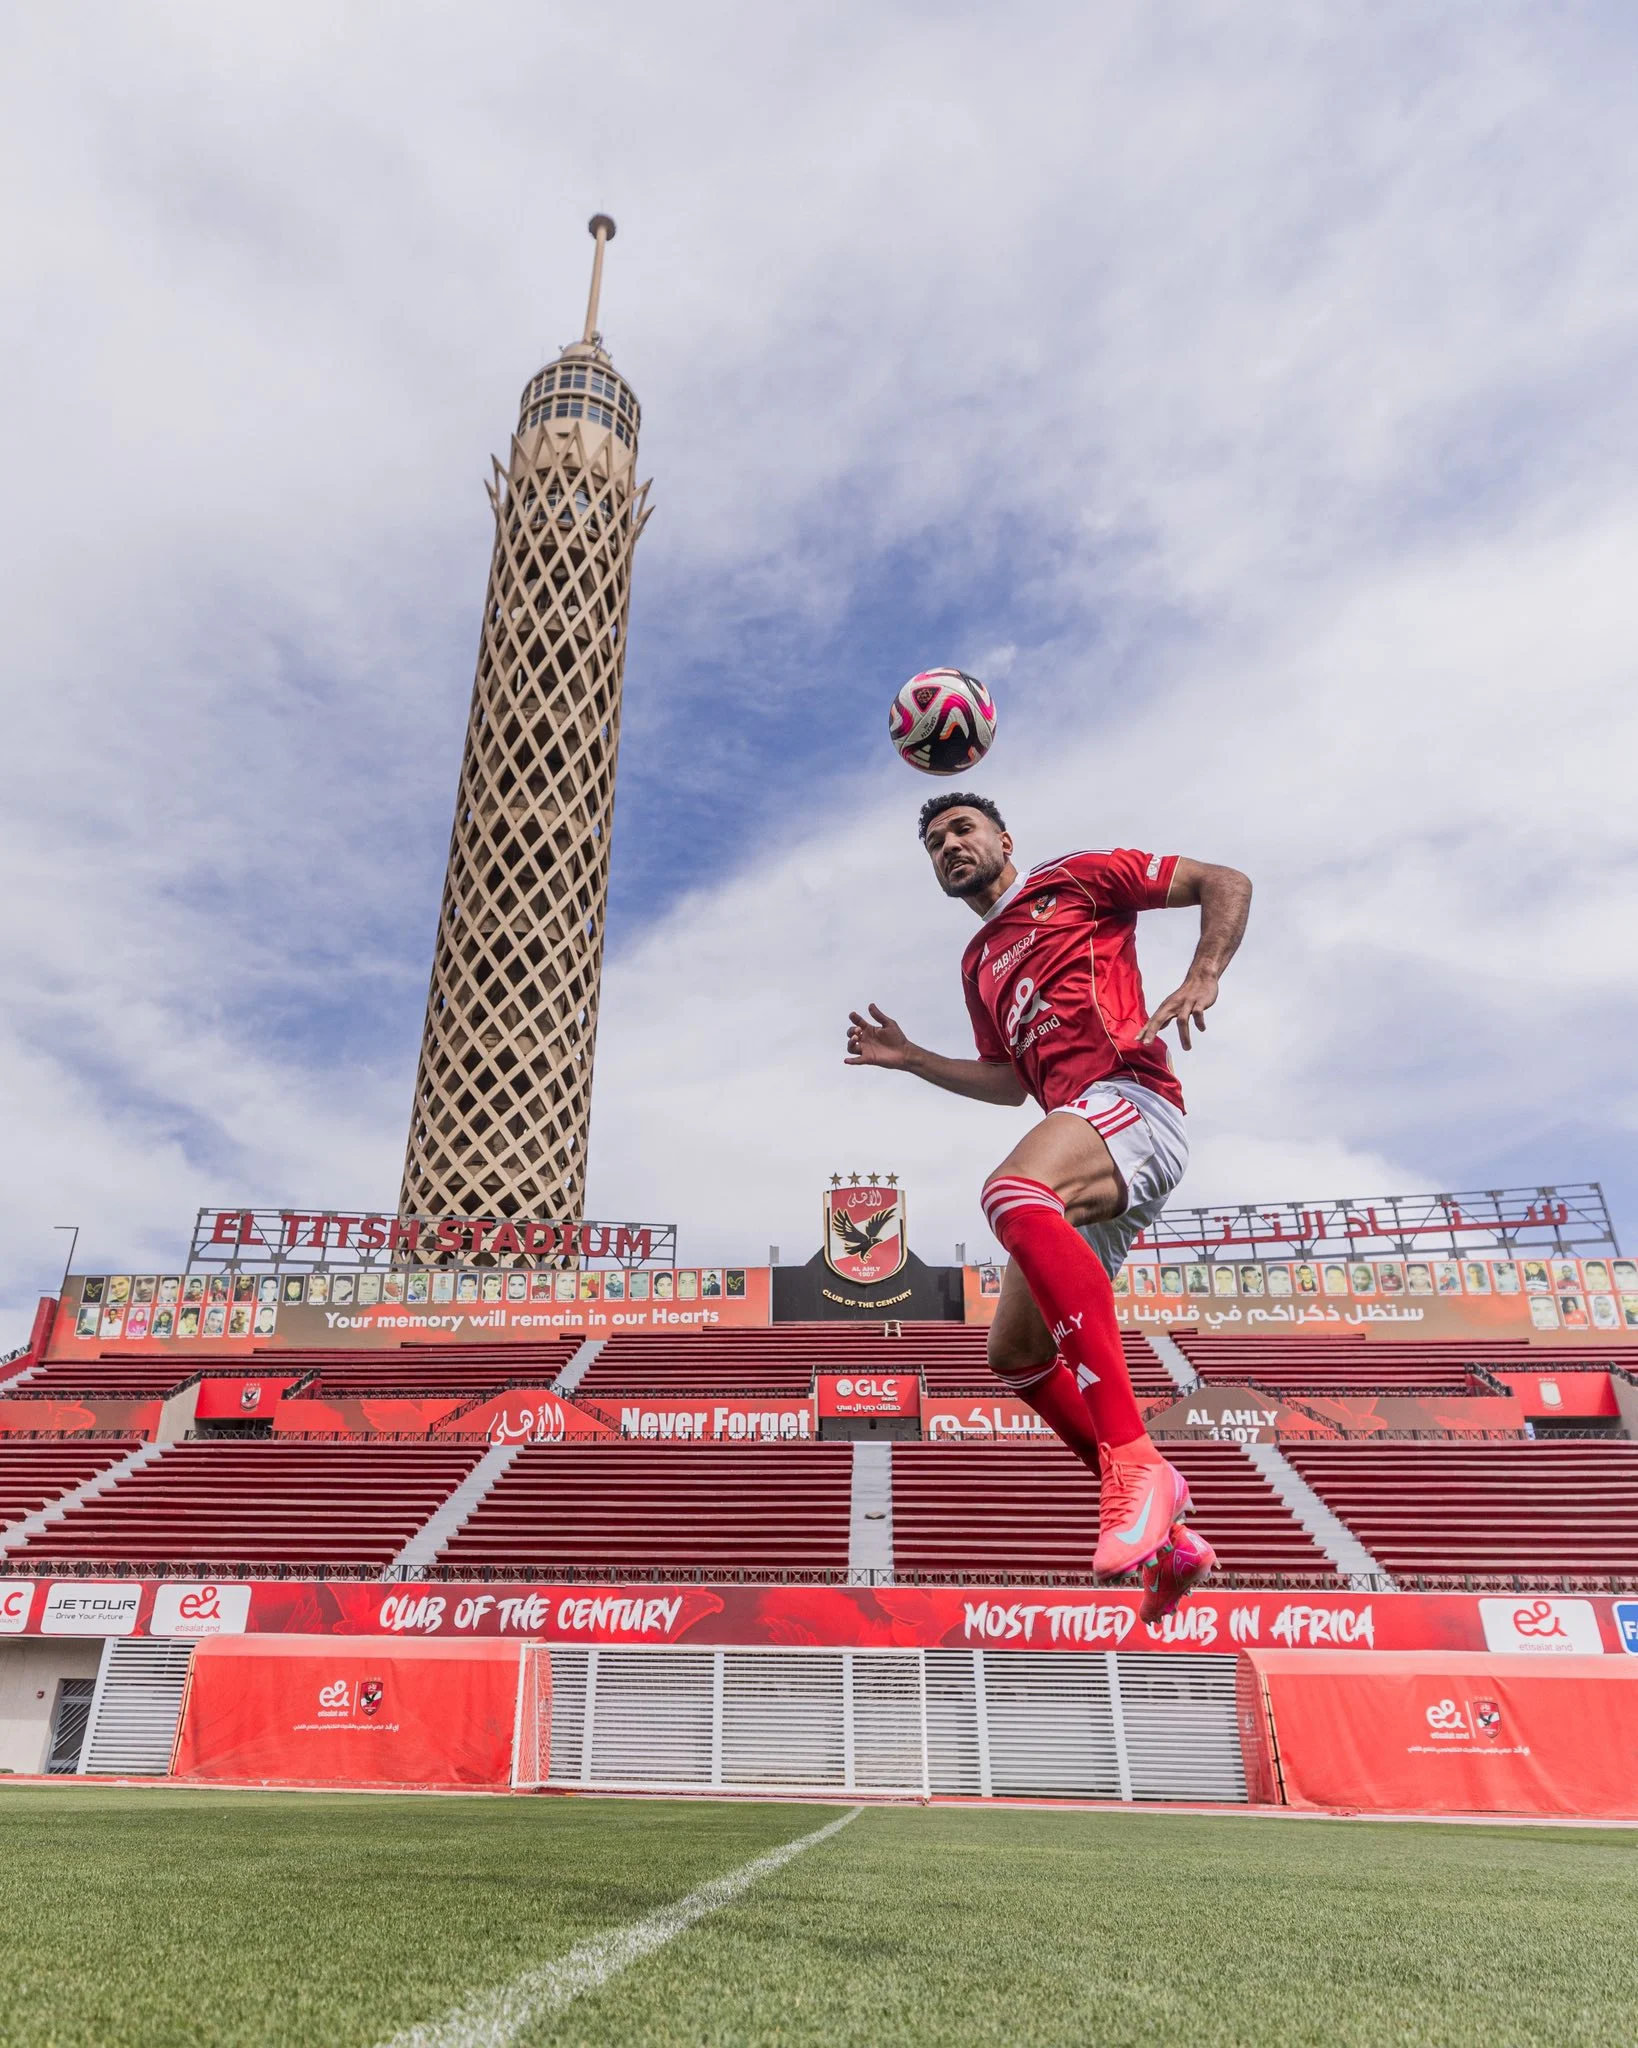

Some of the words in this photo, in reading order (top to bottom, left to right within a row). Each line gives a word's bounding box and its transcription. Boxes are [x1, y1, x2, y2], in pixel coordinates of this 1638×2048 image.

[992, 936, 1031, 976] FABMISR
[1037, 1014, 1061, 1036] and
[210, 1213, 264, 1246] EL
[281, 1214, 421, 1251] TITSH
[434, 1219, 652, 1260] STADIUM
[822, 1289, 843, 1304] CLUB
[844, 1297, 856, 1307] OF
[876, 1289, 913, 1307] CENTURY
[325, 1312, 370, 1329] Your
[377, 1313, 464, 1332] memory
[469, 1310, 506, 1327] will
[511, 1310, 583, 1326] remain
[589, 1309, 607, 1326] in
[612, 1311, 647, 1326] our
[652, 1308, 719, 1325] Hearts
[1133, 1304, 1200, 1325] قلوبنا
[1204, 1304, 1242, 1329] في
[1247, 1304, 1341, 1325] ذكراكم
[1345, 1304, 1425, 1325] ستظل
[855, 1379, 898, 1396] GLC
[621, 1407, 708, 1440] Never
[713, 1407, 811, 1442] Forget
[1186, 1409, 1215, 1425] AL
[1220, 1410, 1278, 1426] AHLY
[1209, 1426, 1260, 1443] 1907
[48, 1599, 136, 1611] JETOUR
[179, 1586, 221, 1619] e&
[379, 1594, 447, 1634] CLUB
[453, 1594, 495, 1631] OF
[497, 1592, 551, 1634] THE
[557, 1594, 683, 1634] CENTURY
[56, 1612, 76, 1620] Drive
[78, 1612, 96, 1621] Your
[98, 1613, 123, 1621] Future
[175, 1623, 204, 1632] etisalat
[205, 1624, 221, 1632] and
[963, 1600, 1045, 1642] MOST
[1045, 1602, 1136, 1645] TITLED
[1229, 1604, 1261, 1642] IN
[1270, 1604, 1376, 1649] AFRICA
[1513, 1600, 1568, 1637] e&
[1519, 1642, 1553, 1651] etisalat
[1556, 1643, 1574, 1651] and
[319, 1680, 350, 1707] e&
[1425, 1699, 1467, 1728] e&
